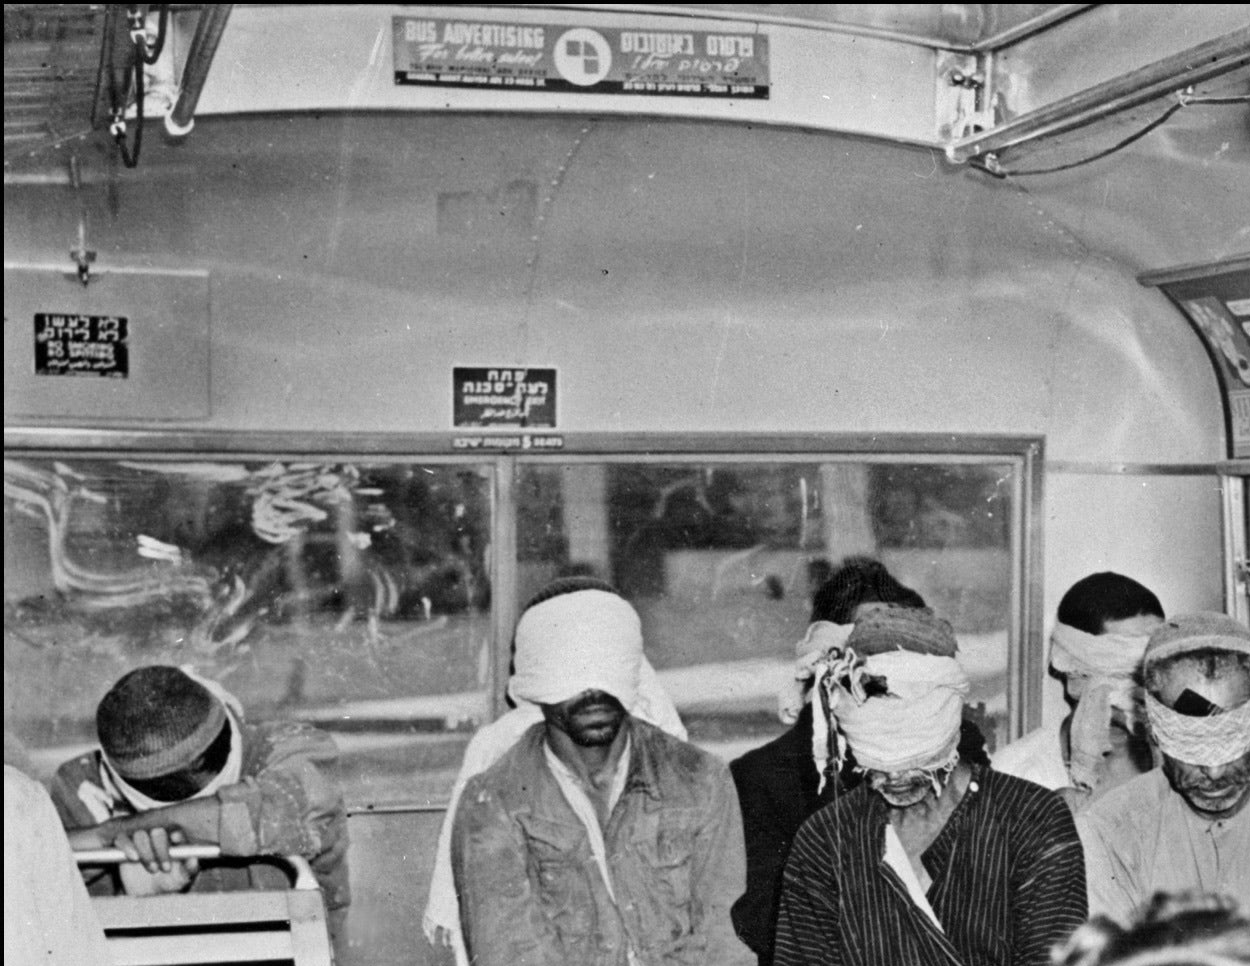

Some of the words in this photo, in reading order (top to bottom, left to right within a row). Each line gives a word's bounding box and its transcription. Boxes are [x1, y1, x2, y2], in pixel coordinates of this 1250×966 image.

[405, 20, 437, 42] BUS
[443, 23, 546, 49] ADVERTISING
[98, 329, 120, 342] לא
[487, 370, 524, 382] פתח
